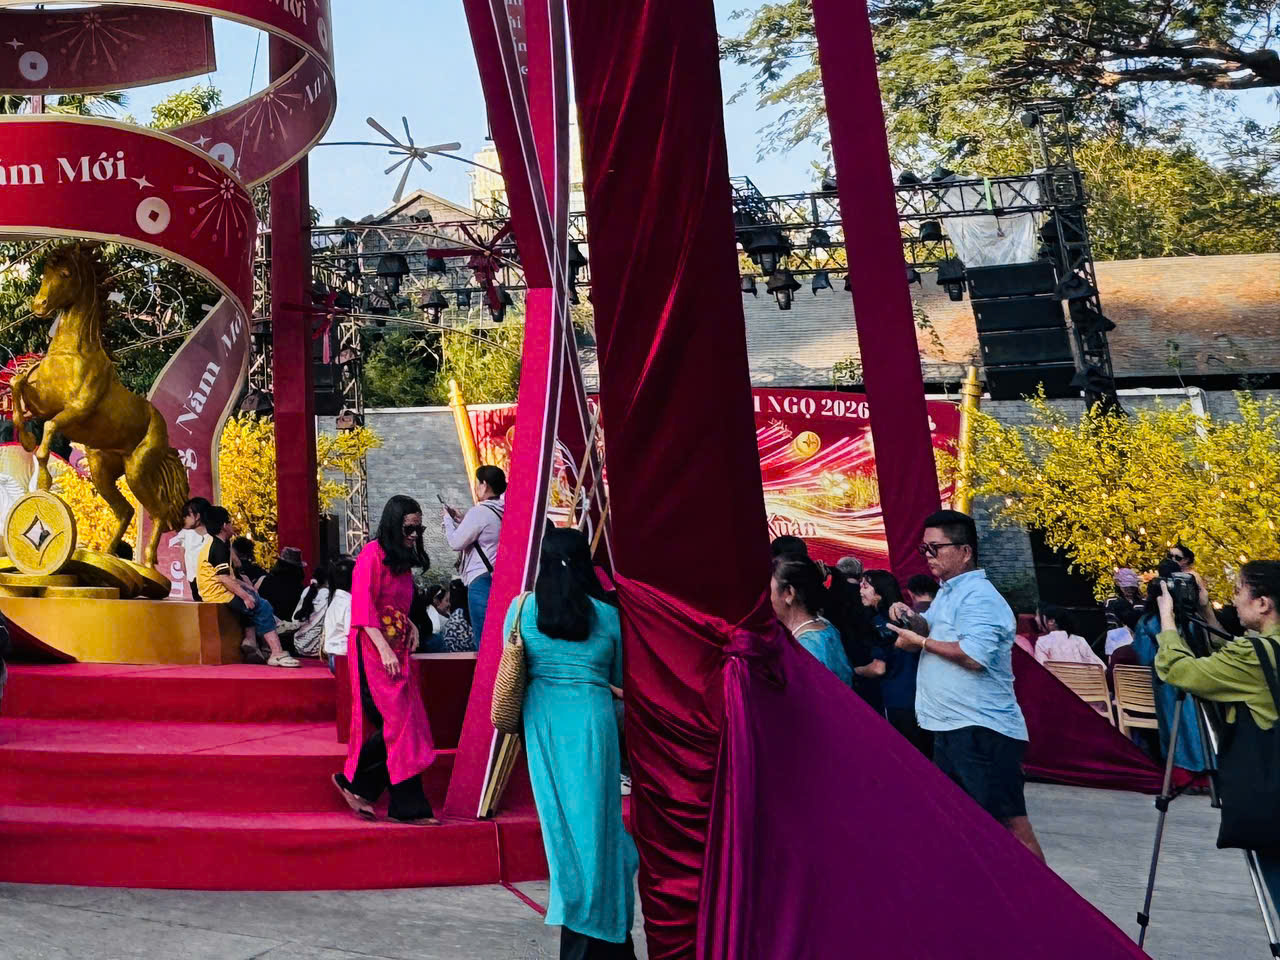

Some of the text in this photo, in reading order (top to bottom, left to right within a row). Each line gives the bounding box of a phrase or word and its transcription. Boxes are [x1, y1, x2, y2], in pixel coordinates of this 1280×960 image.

[57, 150, 127, 183] Mới
[176, 361, 220, 435] Năm
[767, 395, 816, 419] NGỌ
[821, 399, 870, 419] 2026
